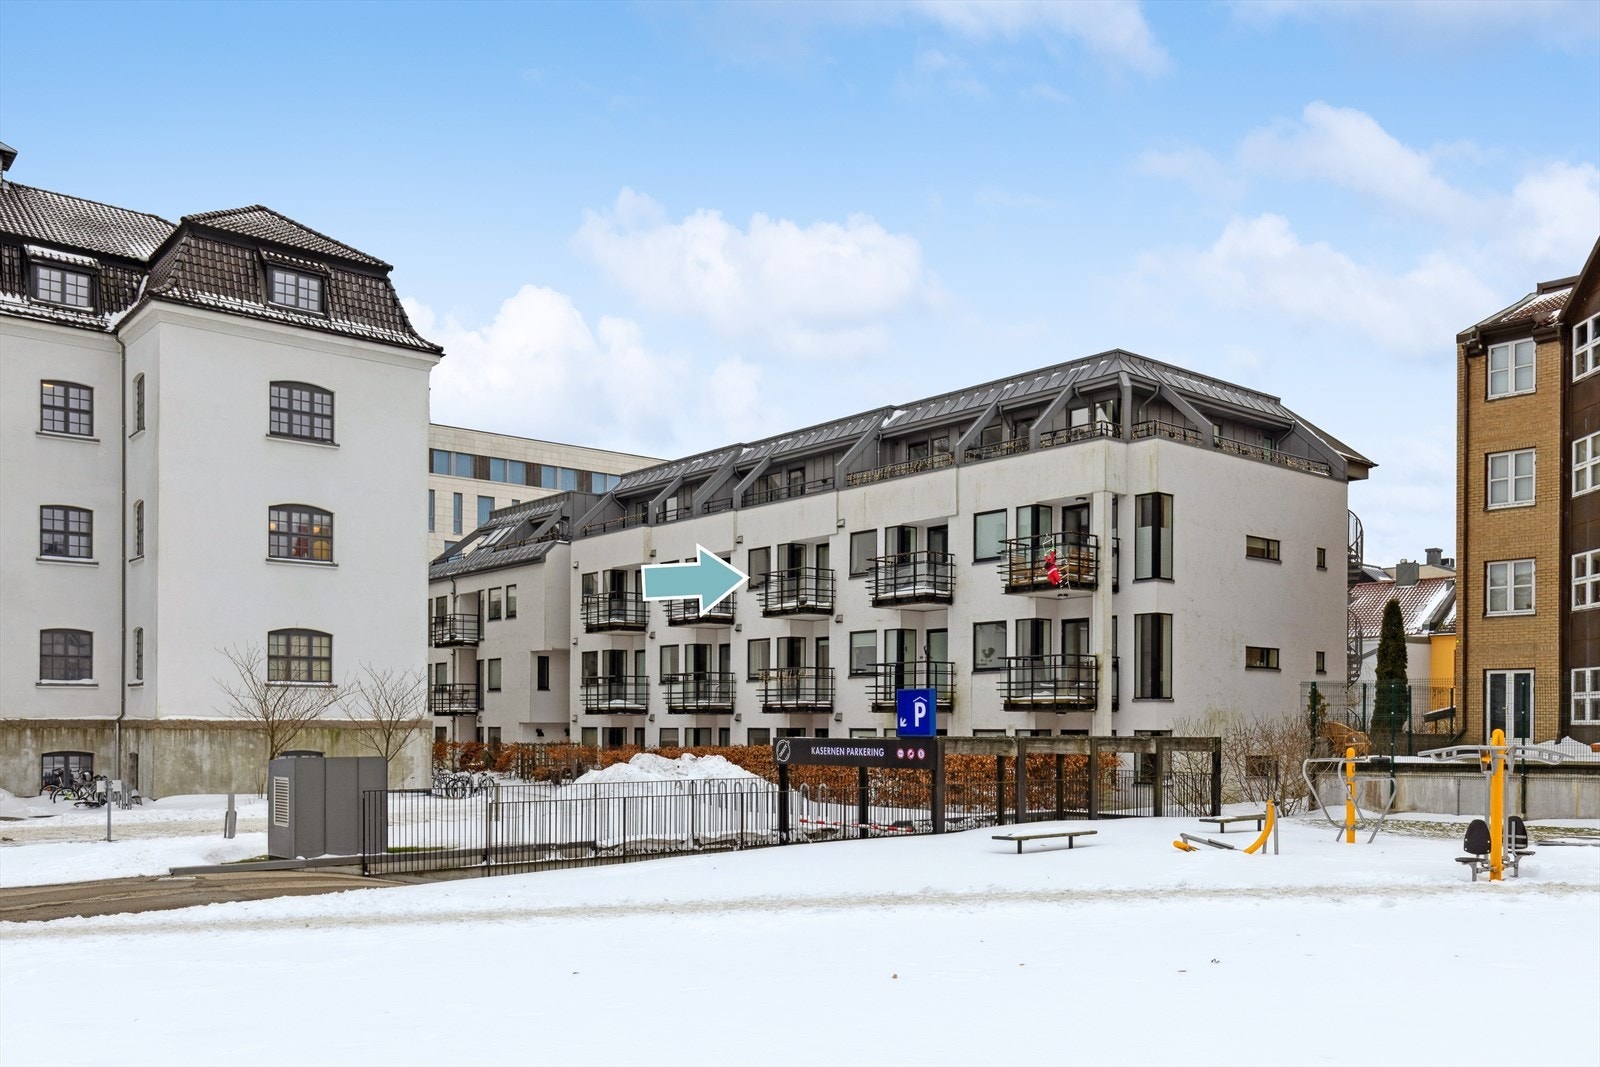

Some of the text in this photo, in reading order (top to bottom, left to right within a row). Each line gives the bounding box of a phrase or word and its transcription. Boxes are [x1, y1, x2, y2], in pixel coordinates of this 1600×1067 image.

[914, 701, 927, 727] P
[811, 746, 885, 757] KASERNEN PARKERING
